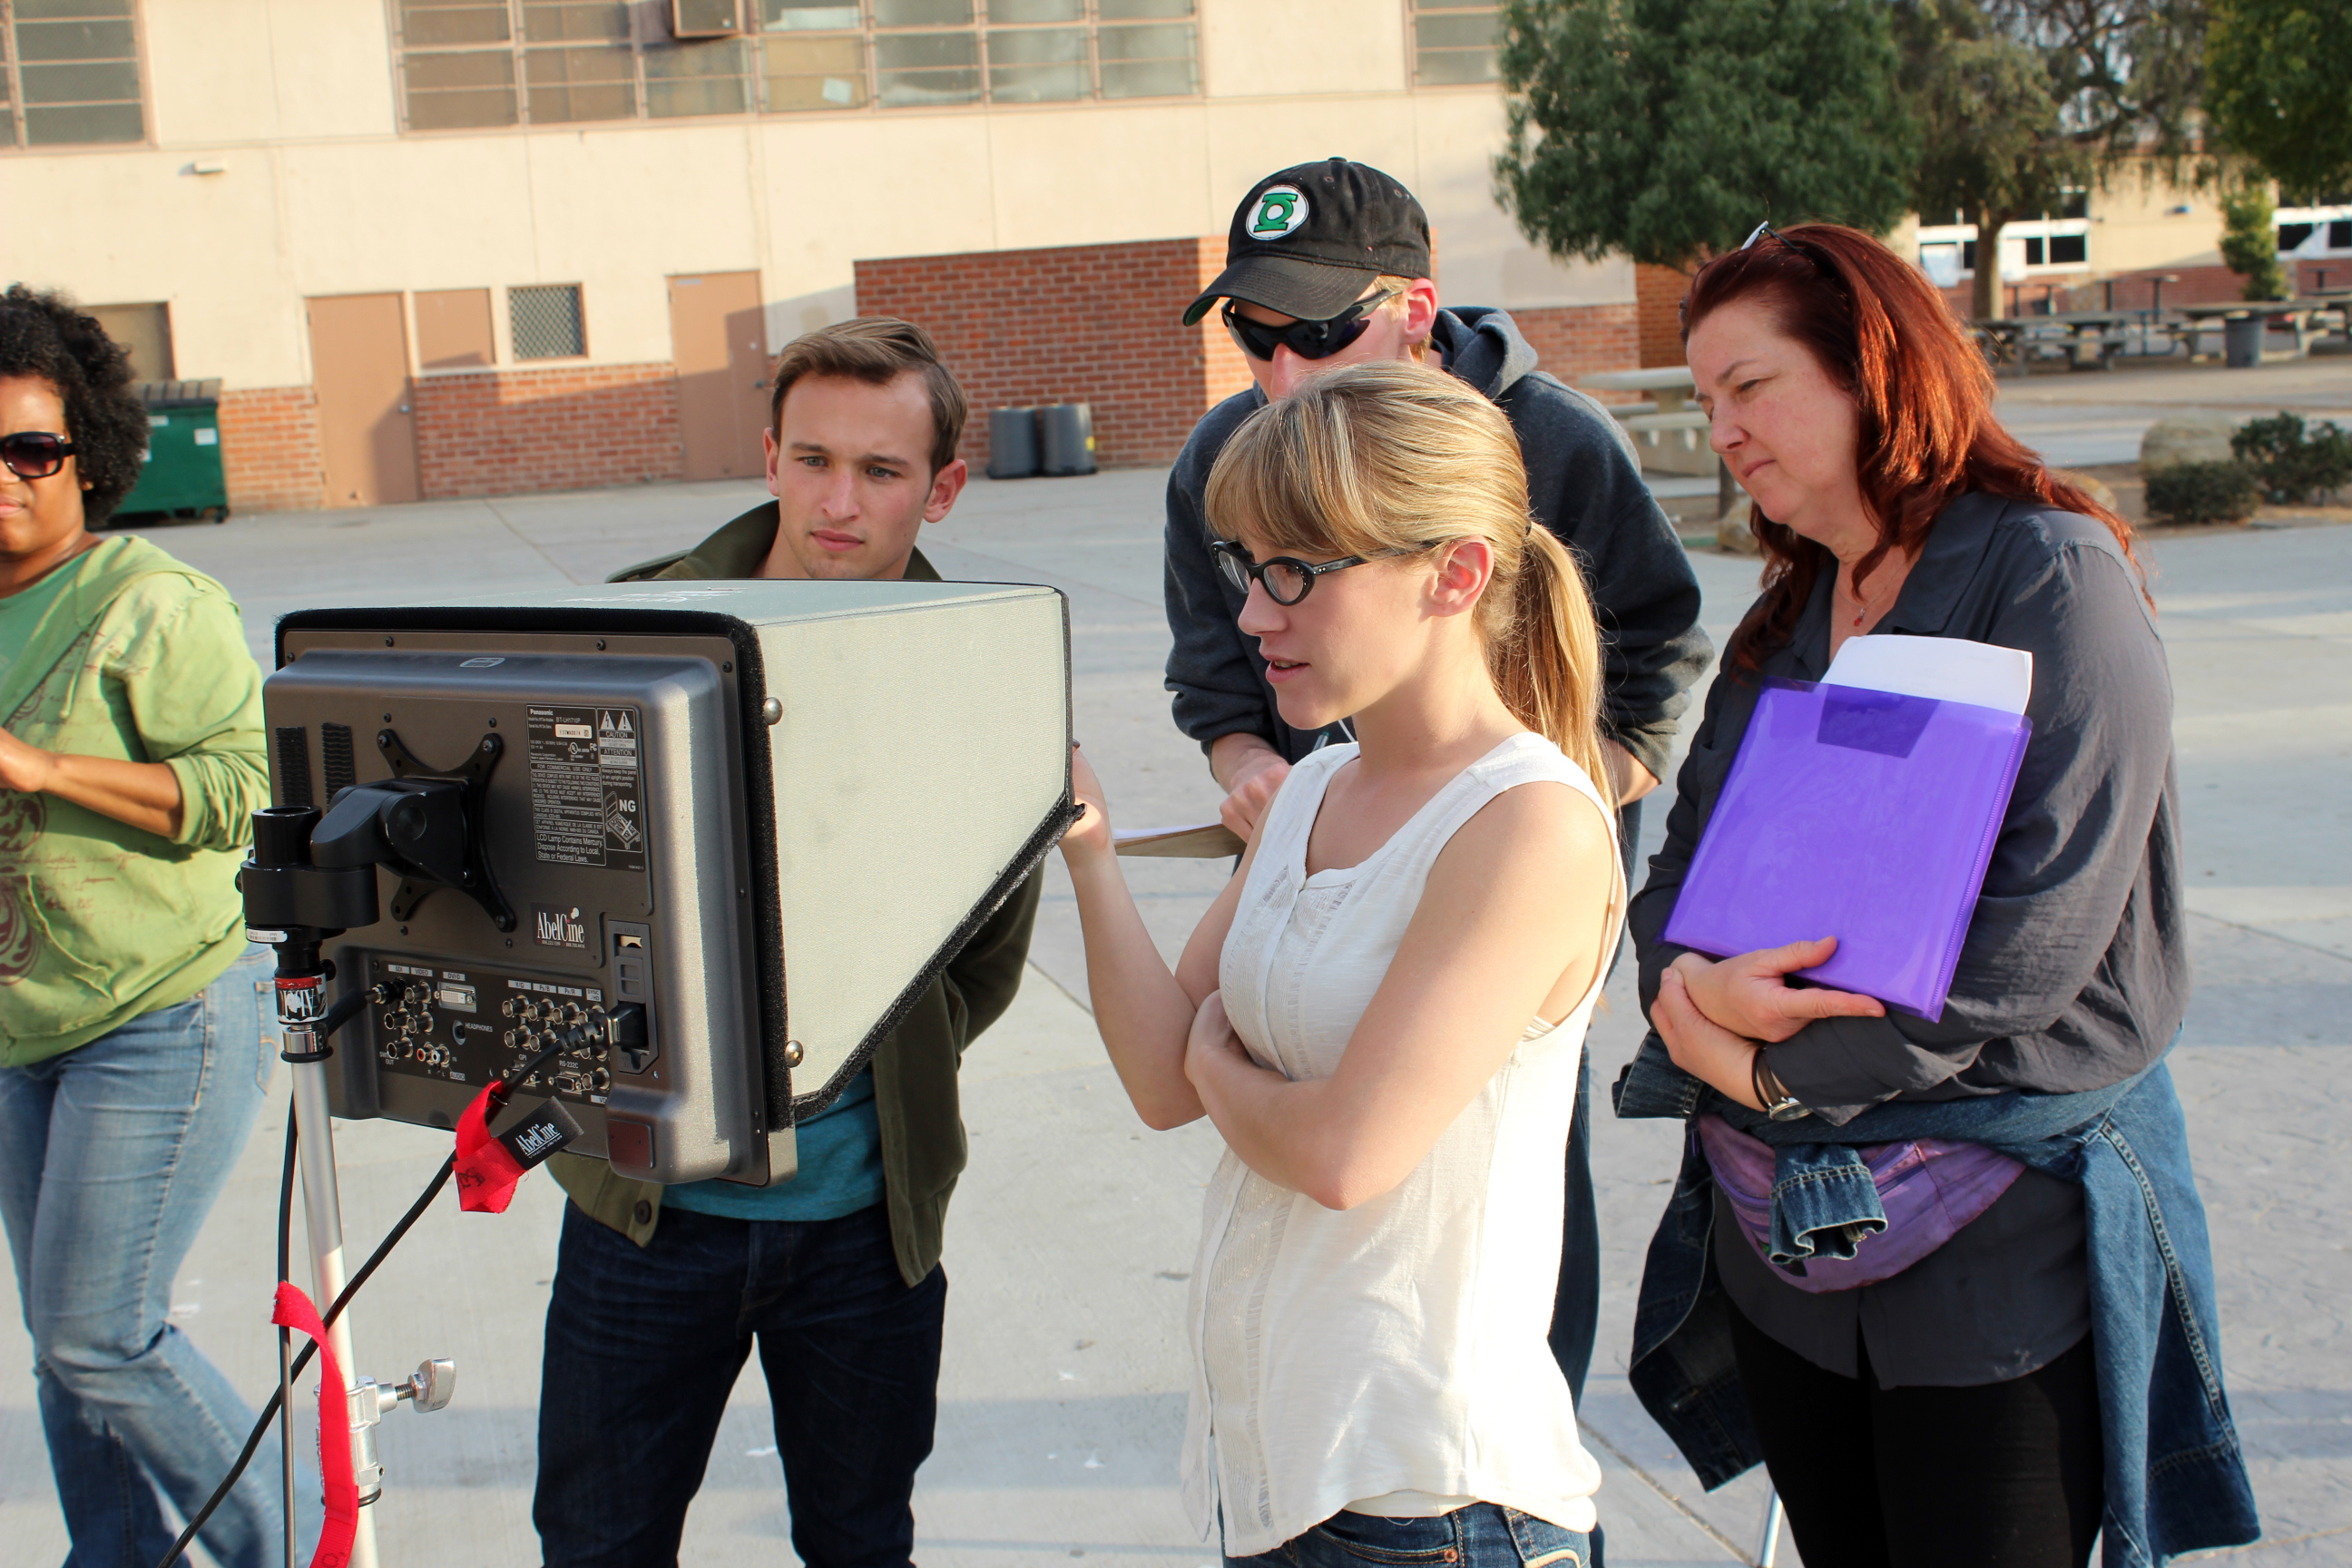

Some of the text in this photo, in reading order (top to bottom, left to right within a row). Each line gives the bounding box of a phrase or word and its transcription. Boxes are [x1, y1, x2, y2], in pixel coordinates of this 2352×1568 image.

[619, 799, 636, 812] NG
[548, 835, 561, 843] Lamp
[562, 836, 582, 844] Contains
[537, 842, 555, 851] Dispose
[557, 845, 579, 855] According
[556, 853, 573, 861] Federal
[537, 911, 584, 943] AbelCine
[466, 1023, 493, 1032] HEADPHONES
[559, 1061, 578, 1069] RS-232C
[515, 1122, 559, 1155] AbelCine
